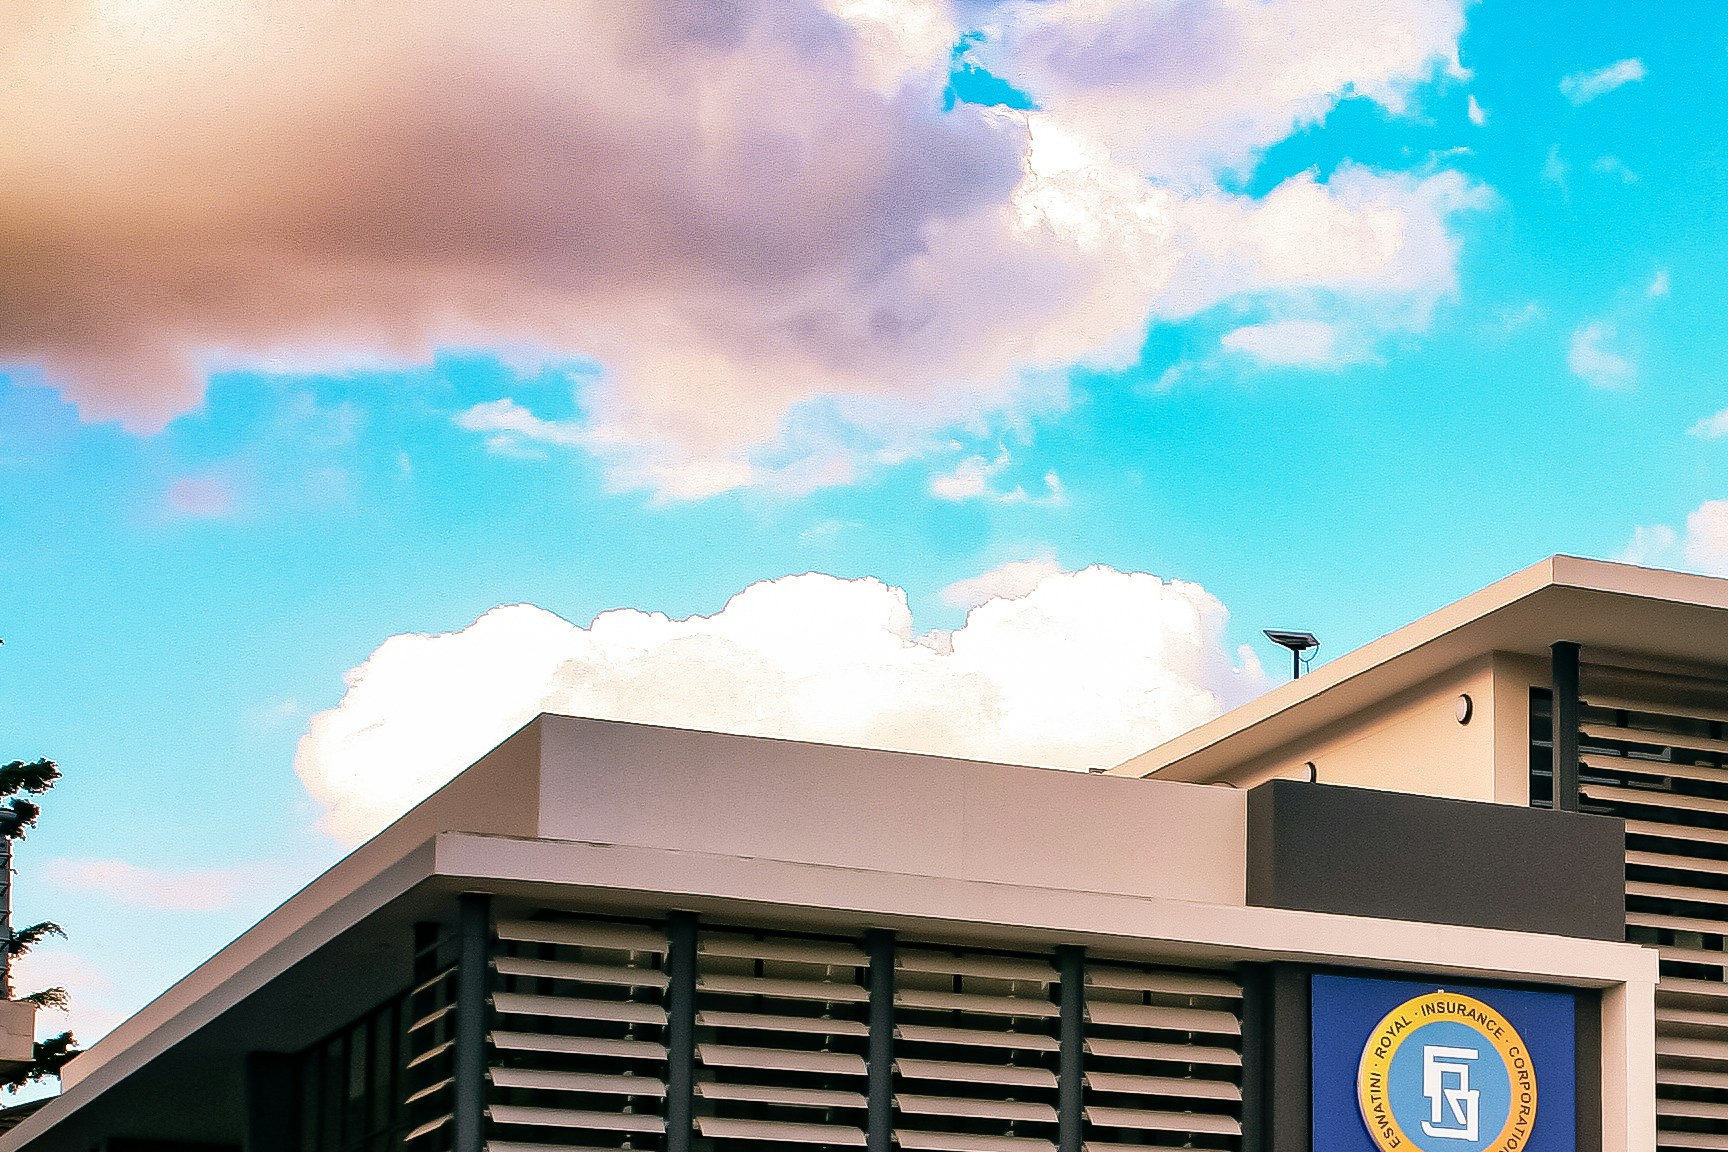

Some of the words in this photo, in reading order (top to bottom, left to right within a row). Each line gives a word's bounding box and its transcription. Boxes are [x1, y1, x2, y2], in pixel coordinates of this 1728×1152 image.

[1375, 1016, 1412, 1059] ROYAL
[1421, 1001, 1505, 1040] INSURANCE
[1370, 1072, 1400, 1149] ESWATINI
